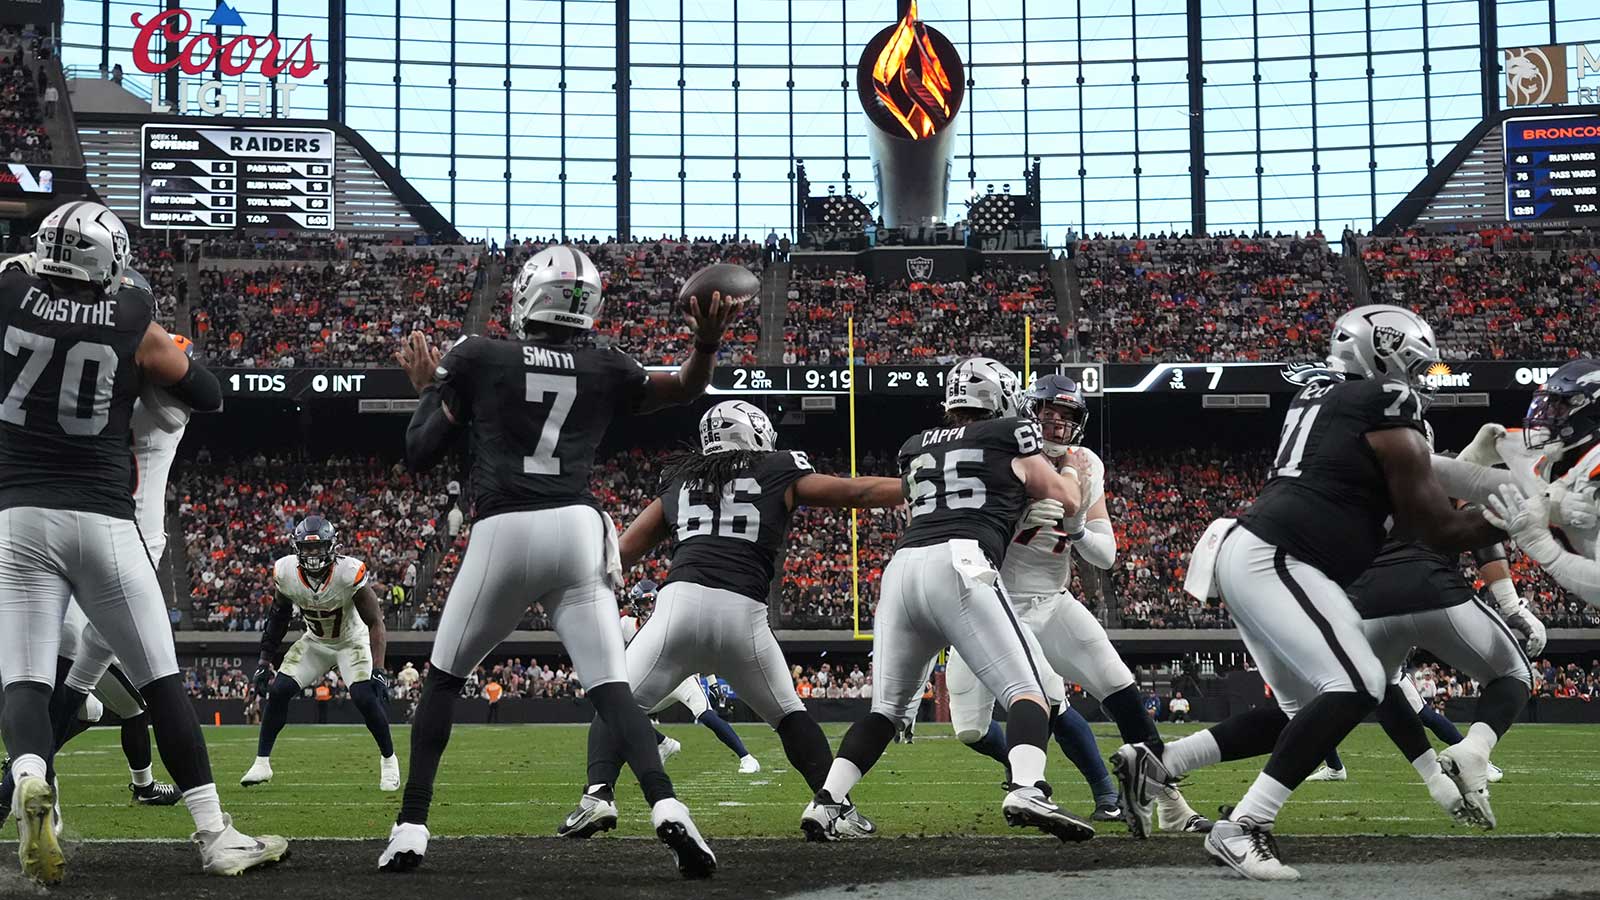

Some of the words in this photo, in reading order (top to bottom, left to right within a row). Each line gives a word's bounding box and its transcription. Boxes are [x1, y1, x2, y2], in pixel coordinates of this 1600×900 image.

[131, 8, 320, 79] Coors
[151, 79, 298, 118] LIGHT
[150, 140, 200, 150] OFFENSE
[230, 136, 320, 152] RAIDERS
[1549, 154, 1570, 162] RUSH
[1571, 152, 1596, 161] YARDS
[151, 162, 176, 170] COMP
[219, 163, 227, 172] 6
[246, 164, 268, 172] PASS
[268, 165, 292, 173] YARDS
[1549, 171, 1570, 179] PASS
[1571, 170, 1596, 178] YARDS
[151, 179, 167, 187] ATT
[219, 180, 227, 189] 6
[246, 181, 268, 189] RUSH
[268, 182, 292, 190] YARDS
[1515, 189, 1531, 198] 122
[1550, 188, 1574, 196] TOTAL
[1574, 187, 1597, 195] YARDS
[150, 196, 170, 204] FIRST
[170, 196, 197, 205] DOWNS
[246, 198, 269, 206] TOTAL
[269, 198, 292, 207] YARDS
[1574, 204, 1597, 213] T.O.P.
[150, 213, 171, 221] RUSH
[172, 213, 197, 222] PLAYS
[219, 214, 226, 222] 1
[246, 215, 270, 223] T.O.P.
[43, 263, 73, 275] RAIDERS
[20, 286, 117, 327] FORSYTHE
[554, 314, 584, 326] RAIDERS
[523, 346, 576, 370] SMITH
[0, 325, 119, 436] 70
[733, 369, 748, 389] 2
[751, 370, 766, 379] ND
[805, 369, 851, 389] 9:19
[916, 371, 929, 387] &
[1172, 368, 1184, 381] 3
[1206, 366, 1223, 390] 7
[229, 374, 240, 392] 1
[244, 374, 286, 392] TDS
[312, 374, 328, 392] 0
[333, 374, 366, 392] INT
[751, 379, 772, 389] QTR
[1169, 381, 1186, 389] TOL
[523, 372, 577, 475] 7
[922, 426, 966, 448] CAPPA
[1267, 404, 1321, 479] 71
[908, 449, 987, 518] 65
[677, 478, 762, 543] 66
[300, 606, 343, 638] 57
